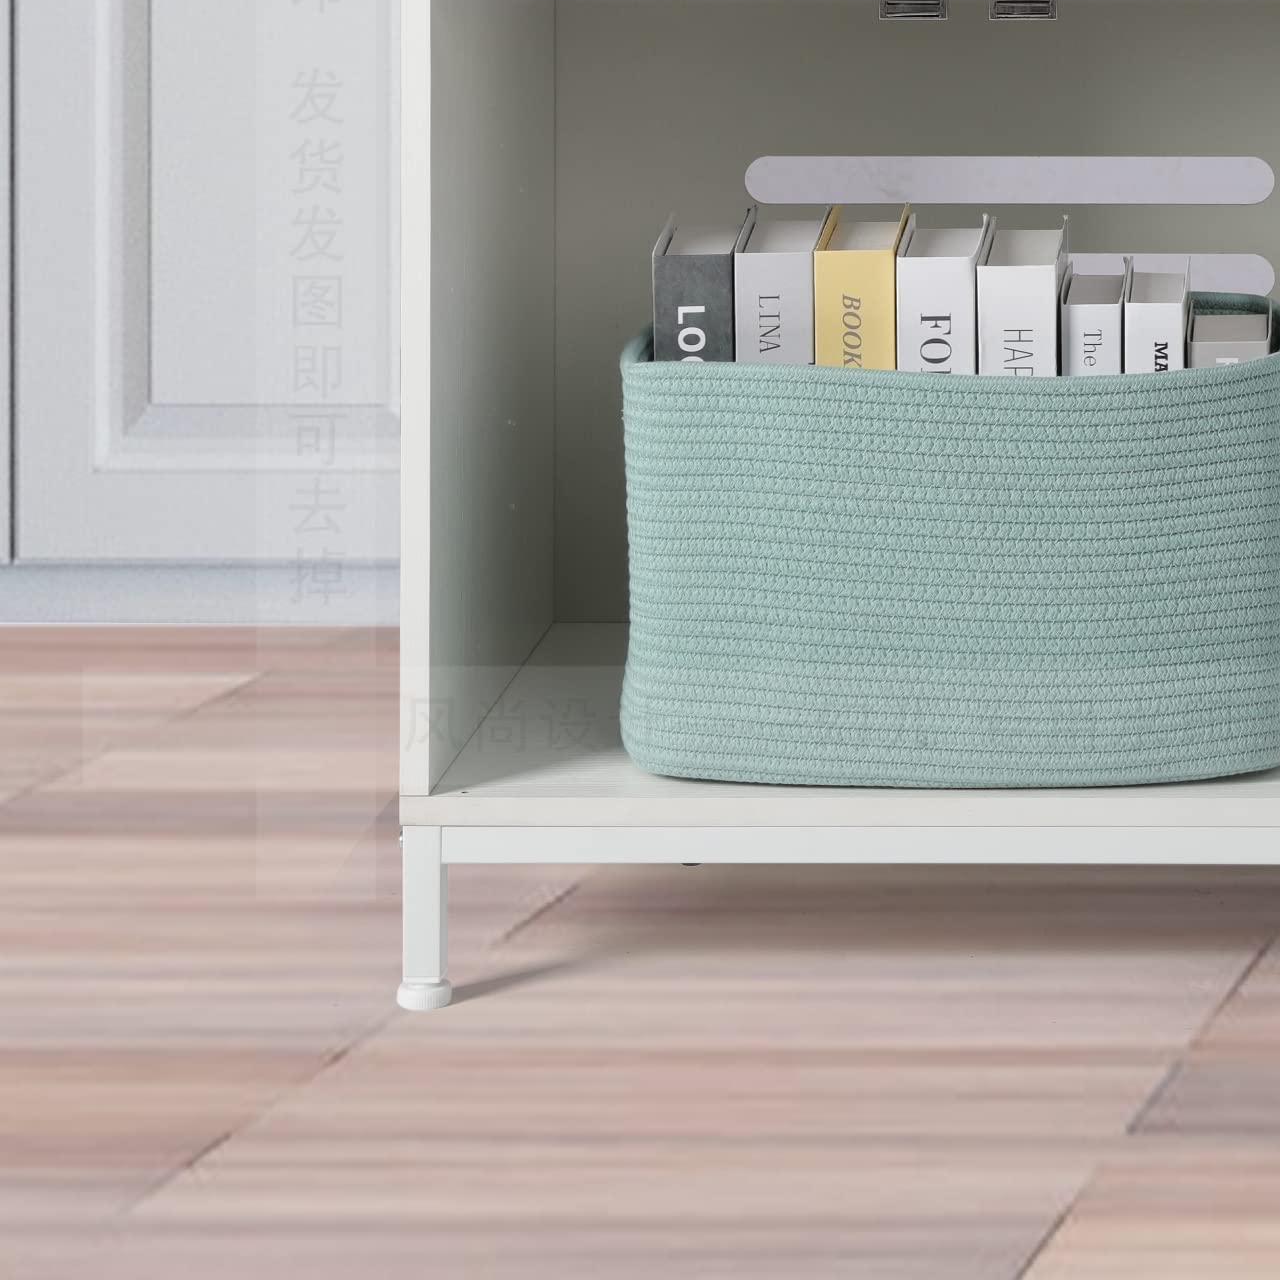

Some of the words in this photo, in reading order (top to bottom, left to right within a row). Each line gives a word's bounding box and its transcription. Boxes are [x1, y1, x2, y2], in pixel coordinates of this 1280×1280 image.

[677, 305, 706, 362] LO
[758, 294, 782, 354] LINA
[919, 312, 952, 374] FO
[1083, 328, 1103, 368] The
